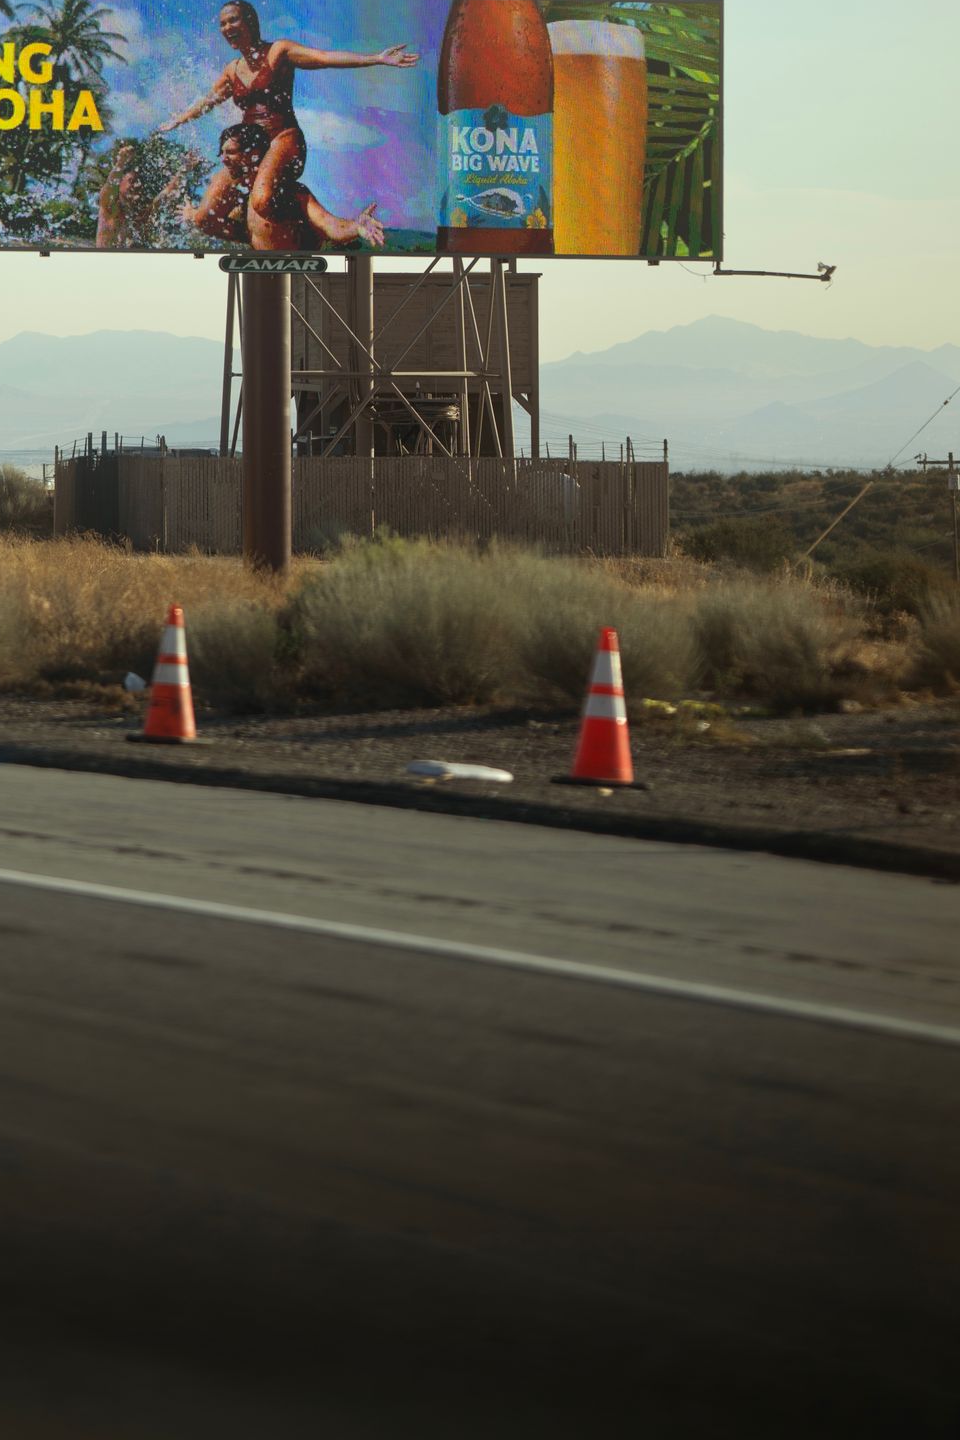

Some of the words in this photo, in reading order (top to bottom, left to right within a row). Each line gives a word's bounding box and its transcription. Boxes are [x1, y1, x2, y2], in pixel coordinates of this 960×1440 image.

[451, 126, 538, 154] KONA
[451, 154, 482, 172] BIG
[486, 155, 540, 173] WAVE
[228, 259, 319, 271] LAMAR
